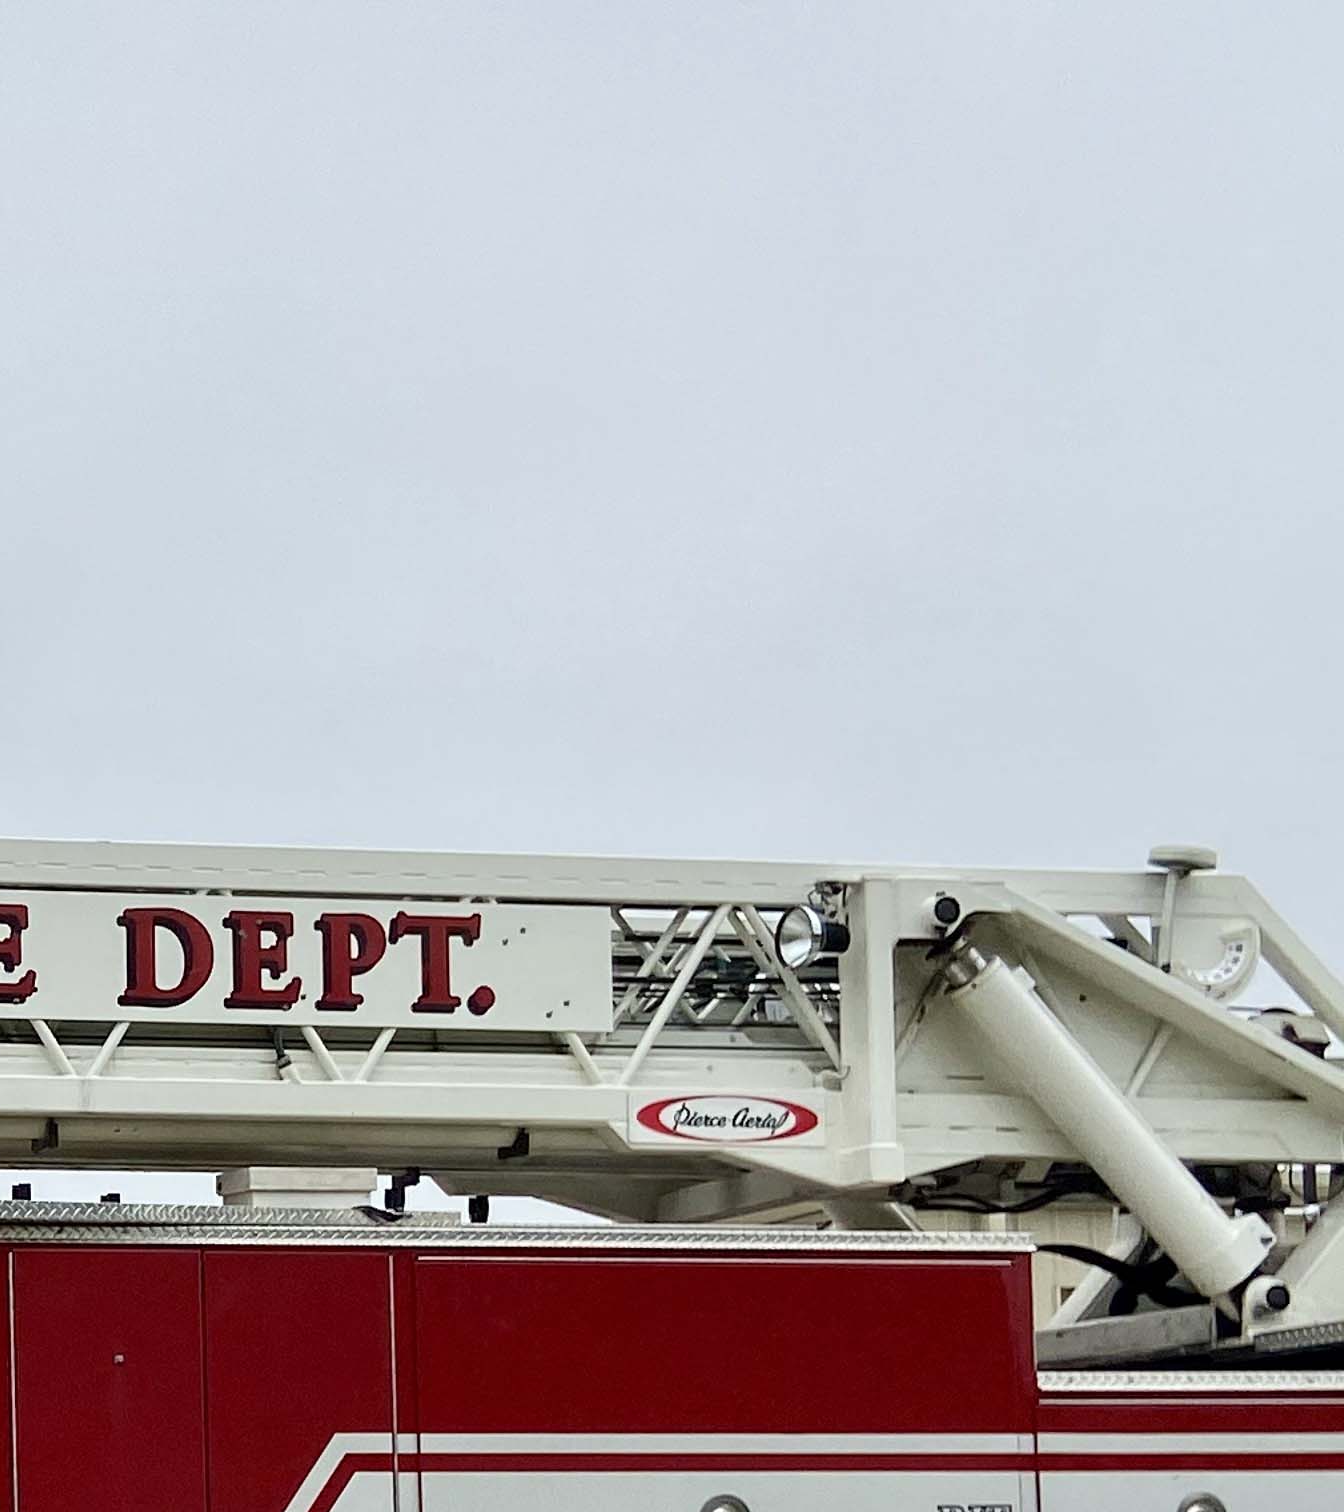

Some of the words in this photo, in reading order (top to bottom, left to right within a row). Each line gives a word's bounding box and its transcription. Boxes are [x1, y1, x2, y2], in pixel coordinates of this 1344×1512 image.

[116, 906, 495, 1016] DEPT.
[673, 1102, 727, 1132] Pierce
[731, 1106, 790, 1136] Aerial
